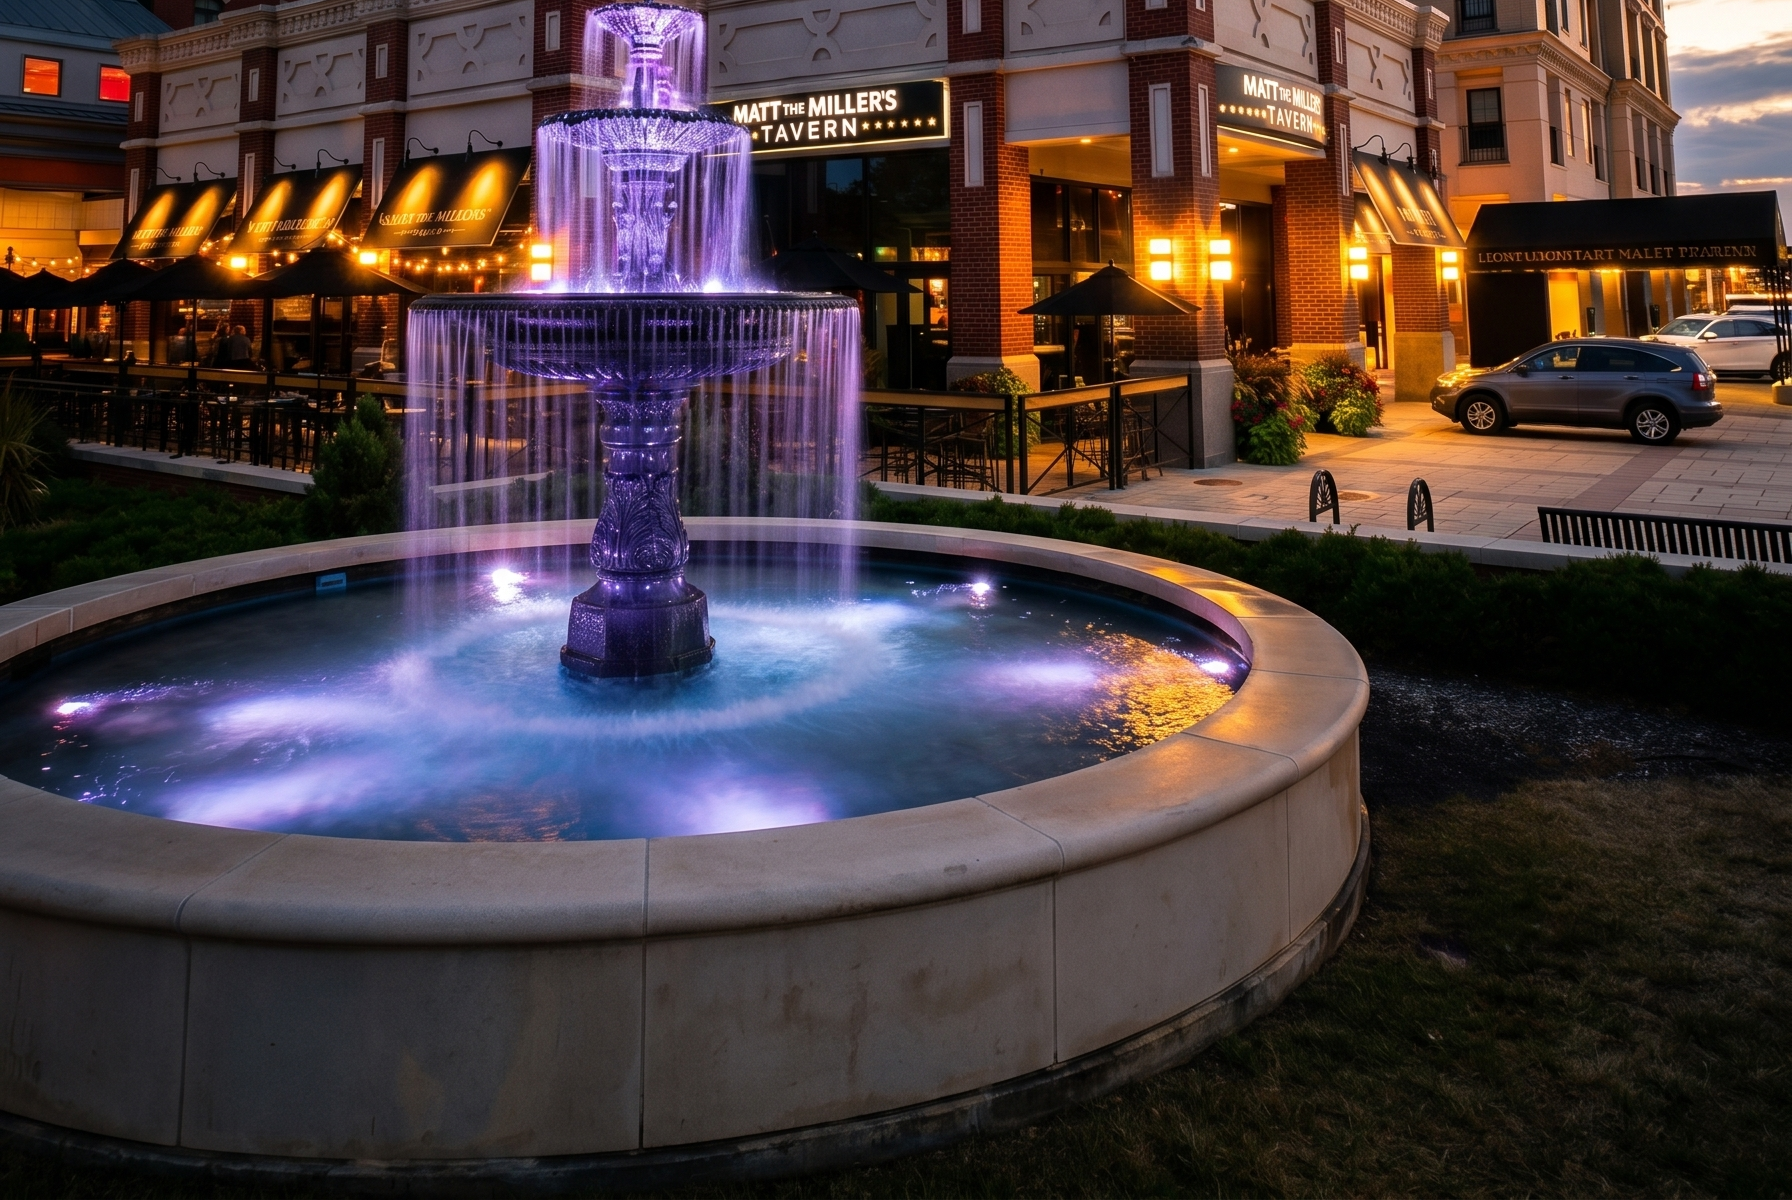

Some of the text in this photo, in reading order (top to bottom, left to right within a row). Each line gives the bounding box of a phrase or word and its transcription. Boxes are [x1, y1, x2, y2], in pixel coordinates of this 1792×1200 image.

[1243, 74, 1279, 101] MATT
[733, 89, 897, 124] MATT THE MILLER'S
[1266, 104, 1313, 134] TAVERN
[761, 117, 857, 143] TAVERN
